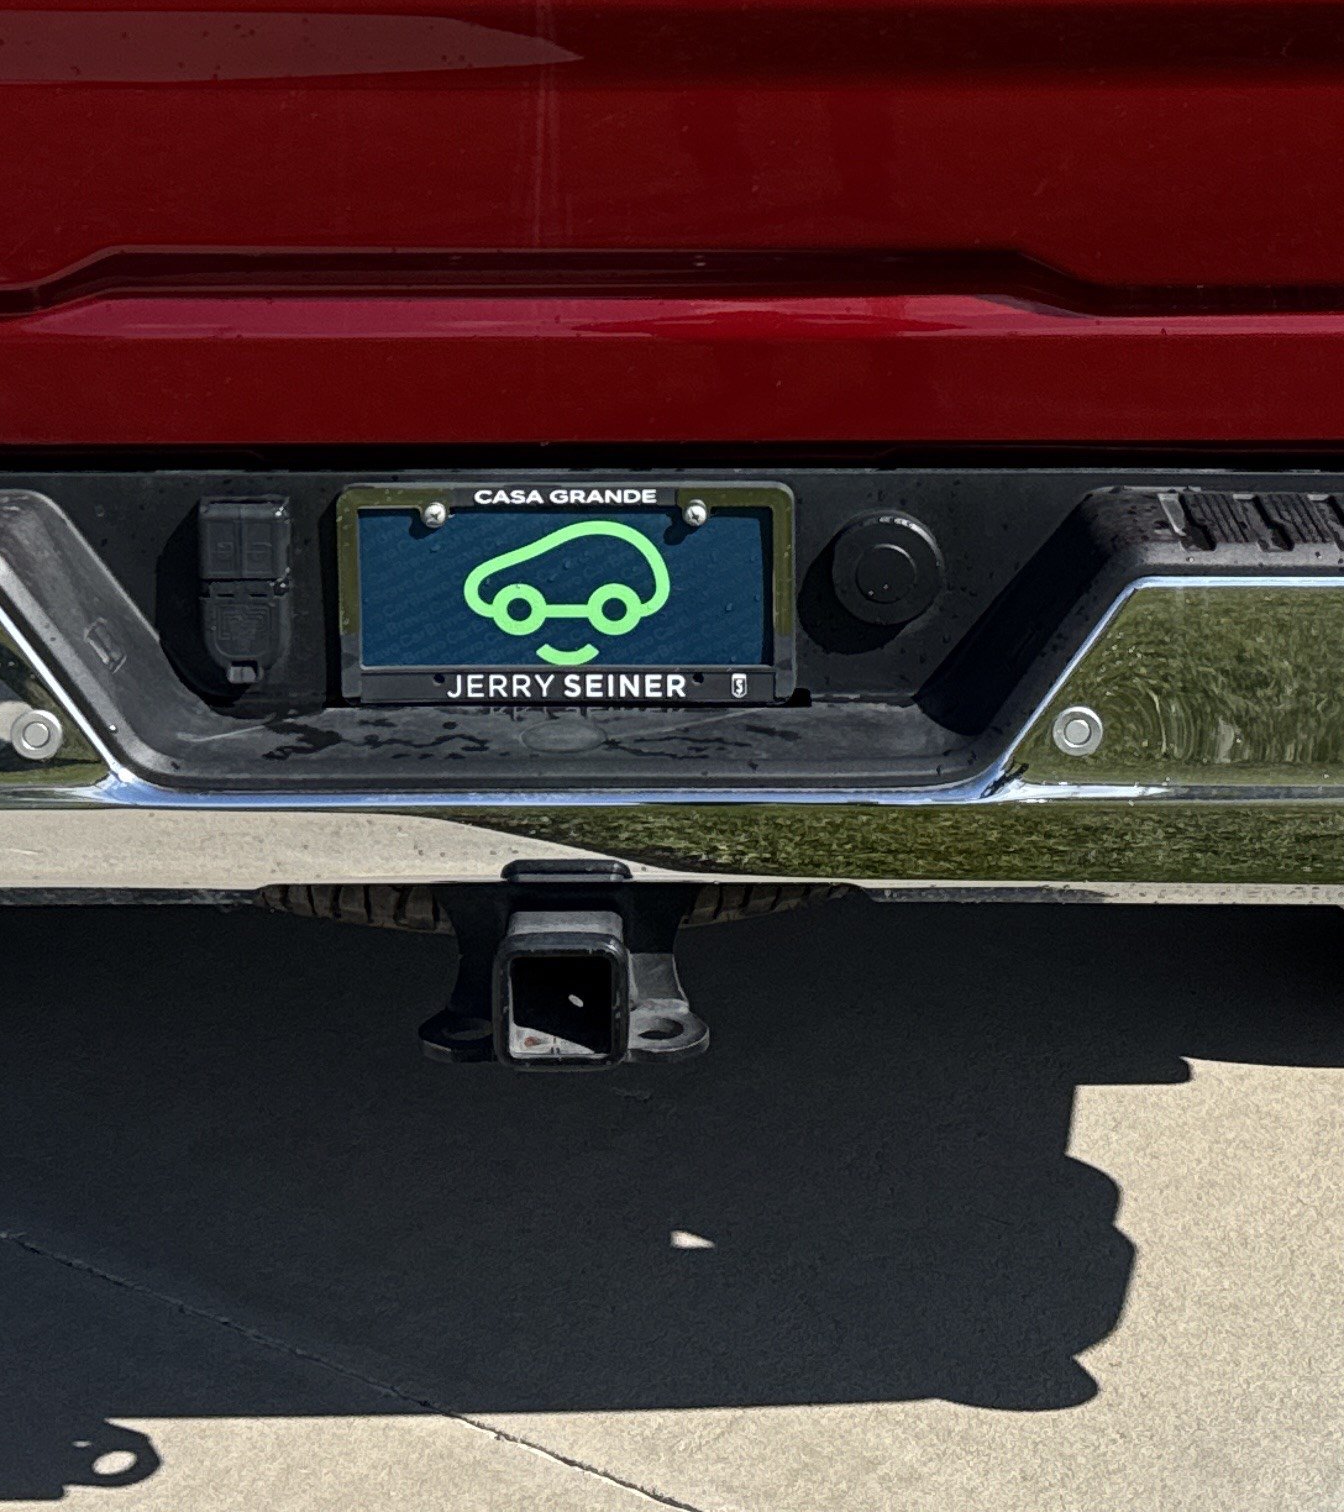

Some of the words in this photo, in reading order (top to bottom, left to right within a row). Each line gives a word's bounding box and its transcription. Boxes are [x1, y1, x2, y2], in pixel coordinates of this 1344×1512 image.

[474, 489, 544, 505] CASA
[549, 489, 657, 505] GRANDE
[447, 675, 555, 698] JERRY
[565, 675, 686, 698] SEINER
